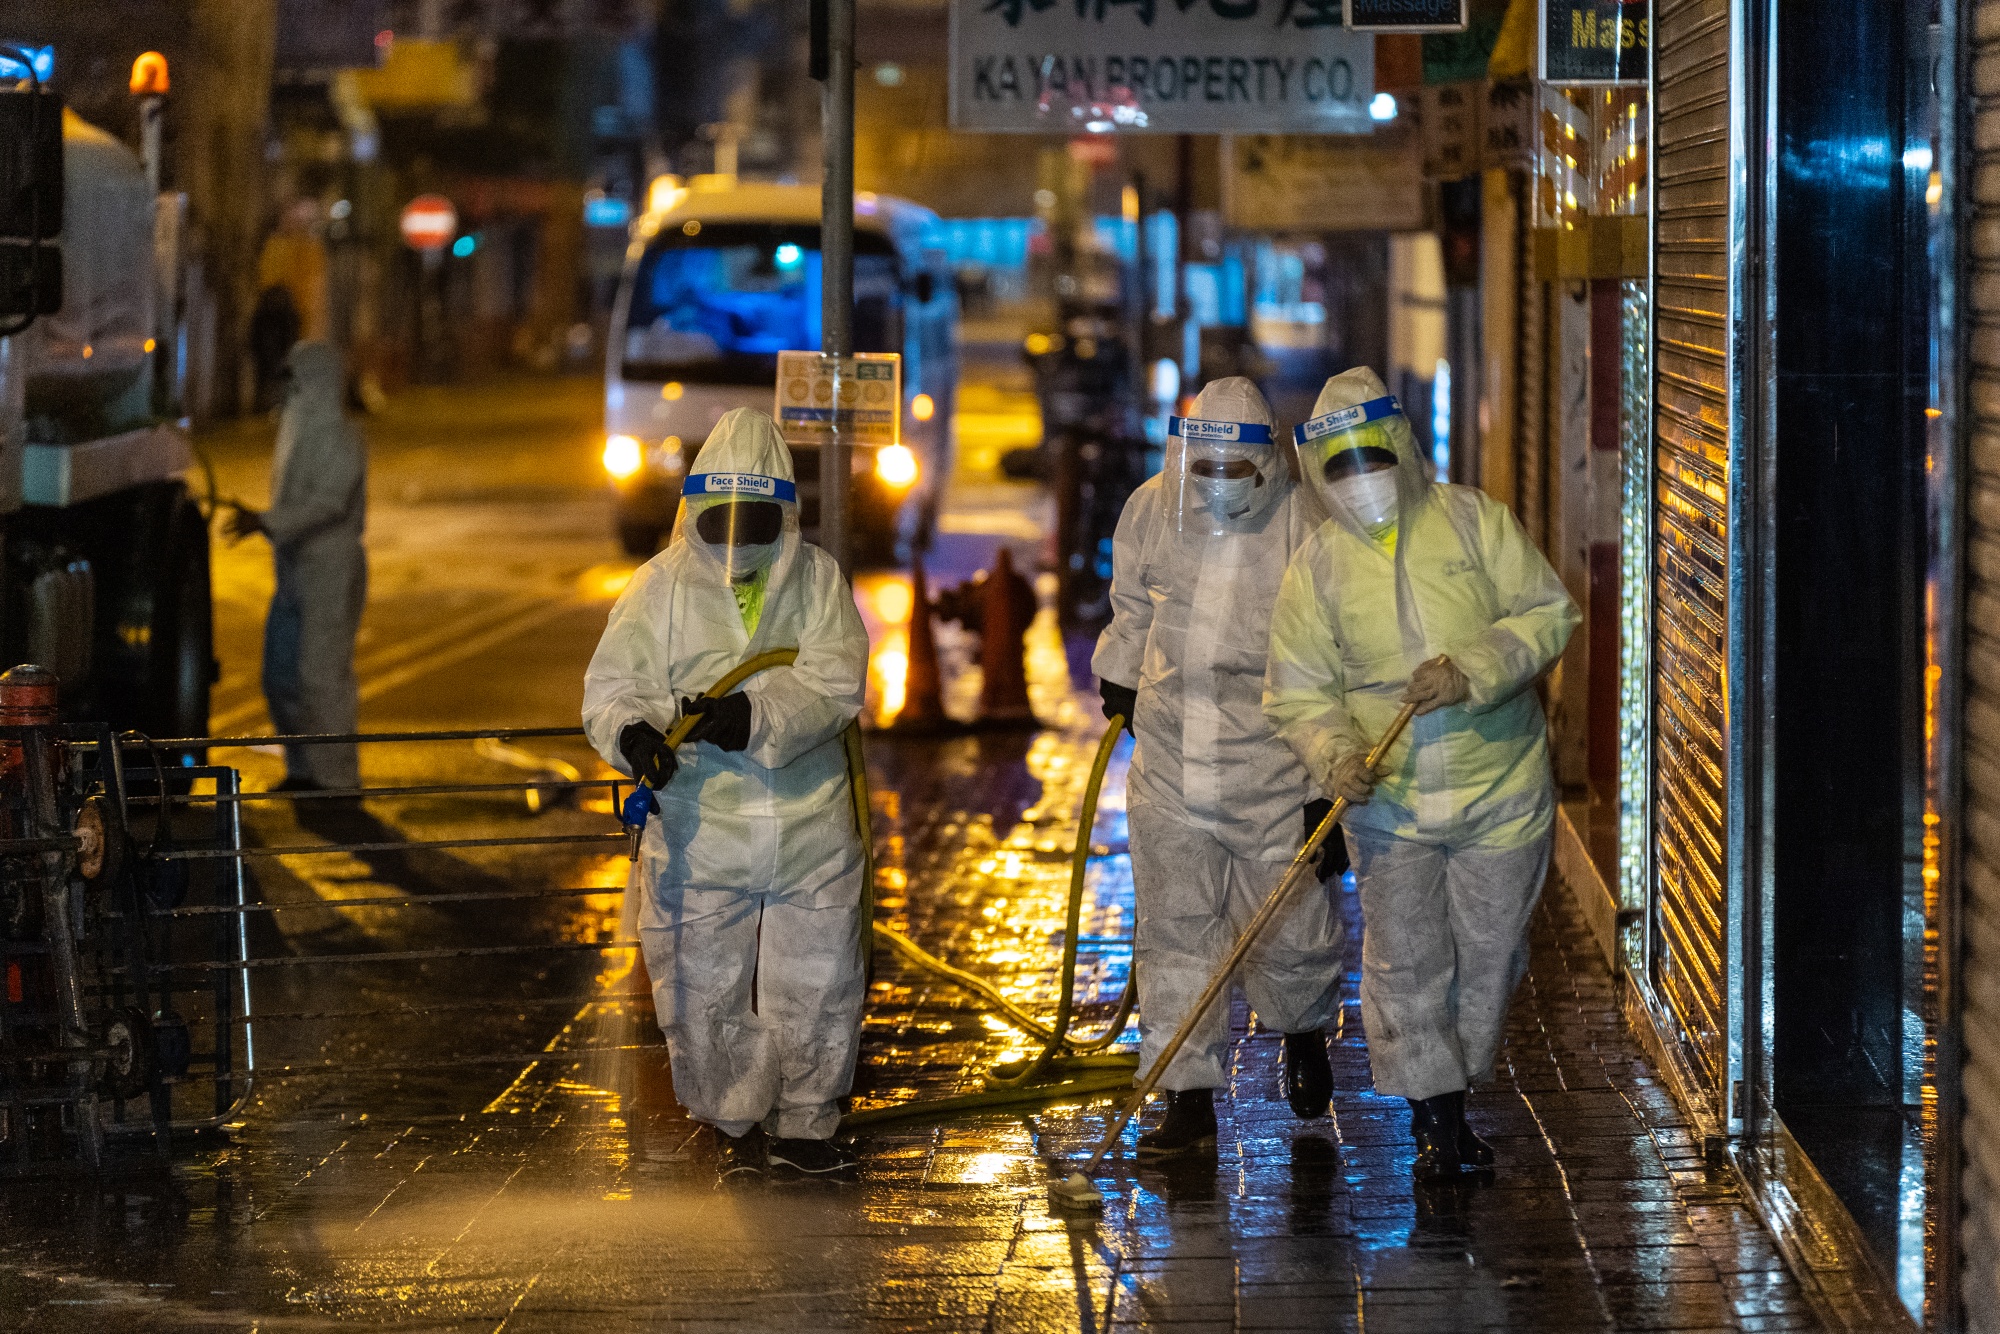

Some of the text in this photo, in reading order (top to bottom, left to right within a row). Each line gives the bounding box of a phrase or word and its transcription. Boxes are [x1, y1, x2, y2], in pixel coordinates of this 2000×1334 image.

[973, 56, 1020, 101] KA
[1026, 56, 1098, 101] YAN
[1106, 54, 1297, 102] PROPERTY
[1182, 421, 1234, 434] Face Shield
[1307, 409, 1358, 433] Face Shield
[711, 476, 769, 489] Face Shield
